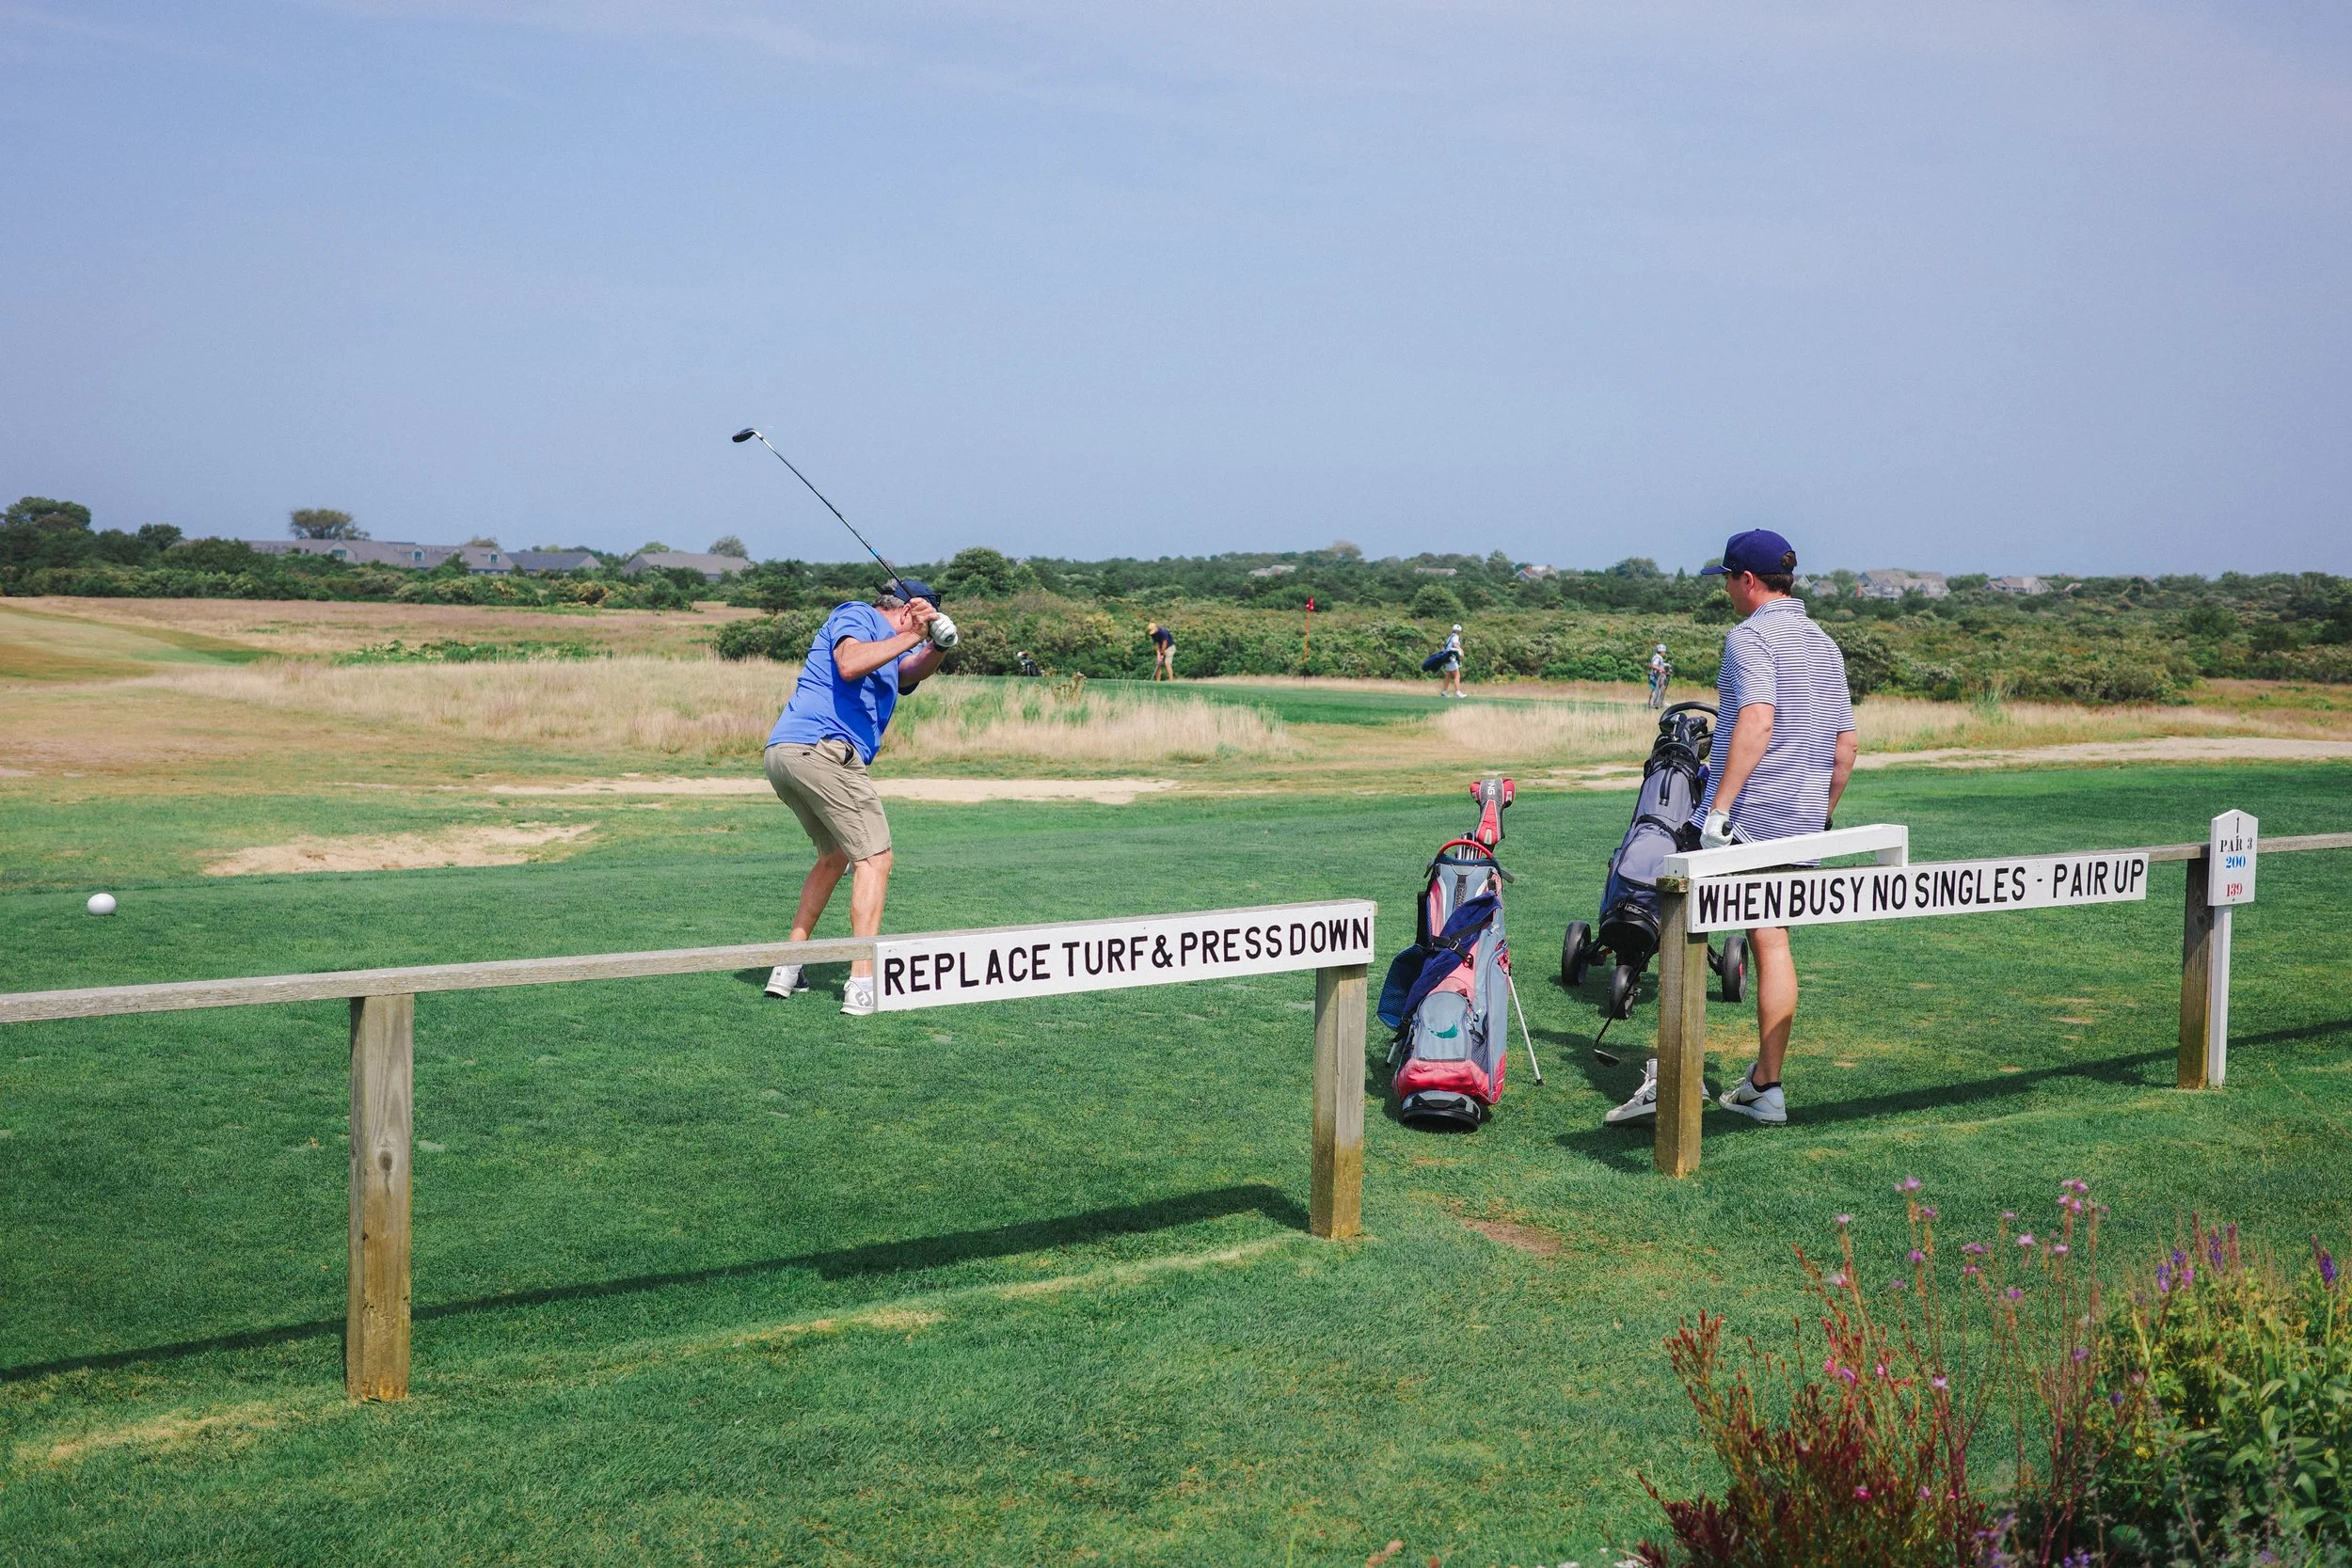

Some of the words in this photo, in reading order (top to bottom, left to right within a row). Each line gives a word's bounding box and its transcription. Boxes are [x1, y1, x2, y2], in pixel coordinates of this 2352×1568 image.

[2235, 816, 2240, 834] 1
[2220, 837, 2243, 852] PAR
[2247, 837, 2253, 850] 3
[2226, 855, 2246, 868] 200
[1698, 880, 1783, 925] WHEN
[1788, 876, 1866, 918] BUSY
[1872, 873, 1908, 912] NO
[1915, 866, 2027, 909] SINGLES
[2053, 861, 2109, 899] PAIR
[2114, 859, 2145, 894] UP
[2226, 883, 2243, 896] 139
[883, 943, 1052, 996] REPLACE
[1061, 935, 1150, 977] TURF
[1181, 925, 1282, 967] PRESS
[1289, 916, 1370, 957] DOWN
